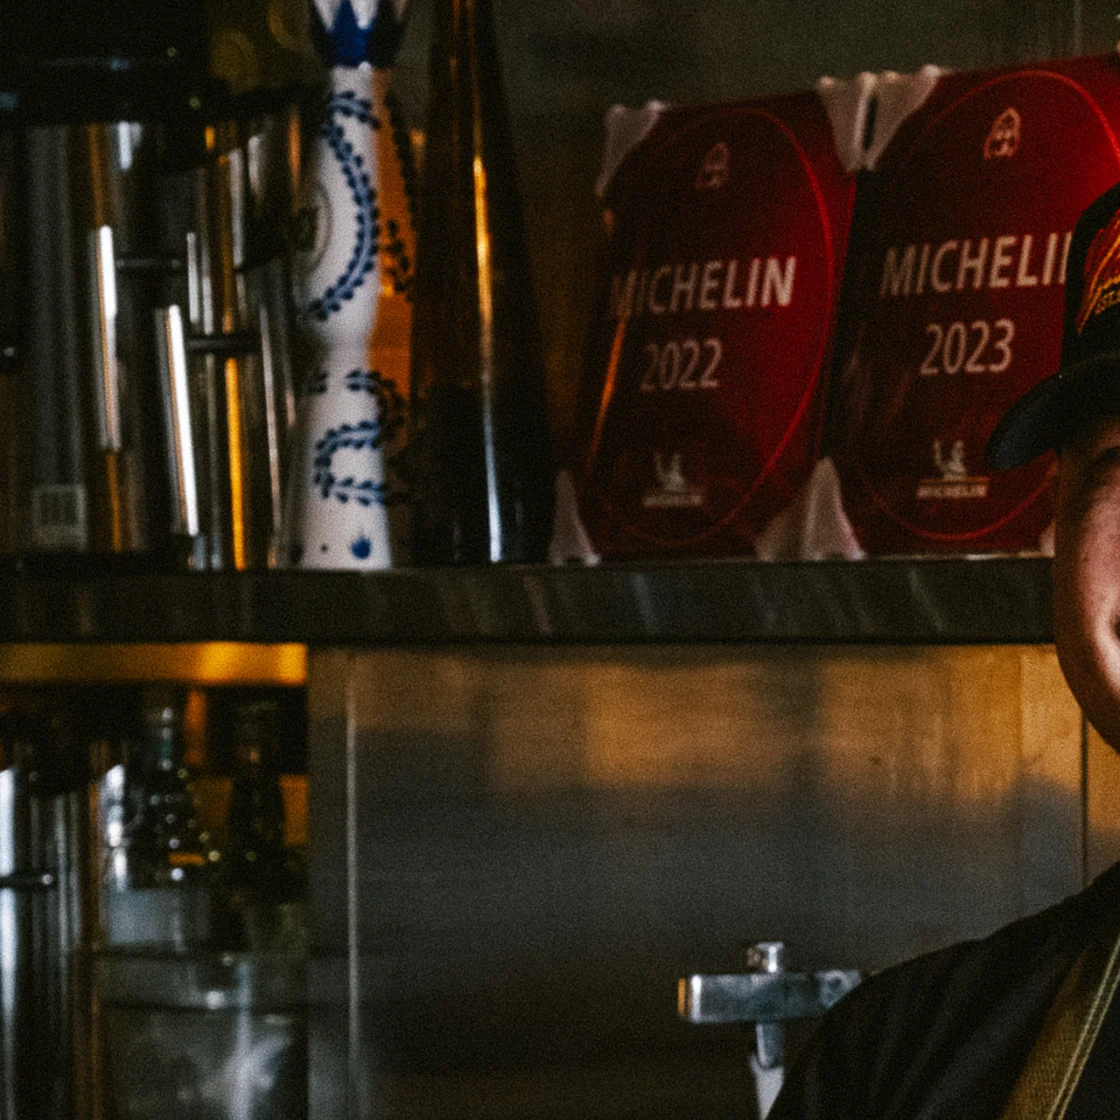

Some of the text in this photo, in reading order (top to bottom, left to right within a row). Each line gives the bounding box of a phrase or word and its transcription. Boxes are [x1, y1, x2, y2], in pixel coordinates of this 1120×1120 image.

[608, 255, 798, 318] MICHELIN
[640, 337, 724, 393] 2022
[920, 318, 1016, 374] 2023
